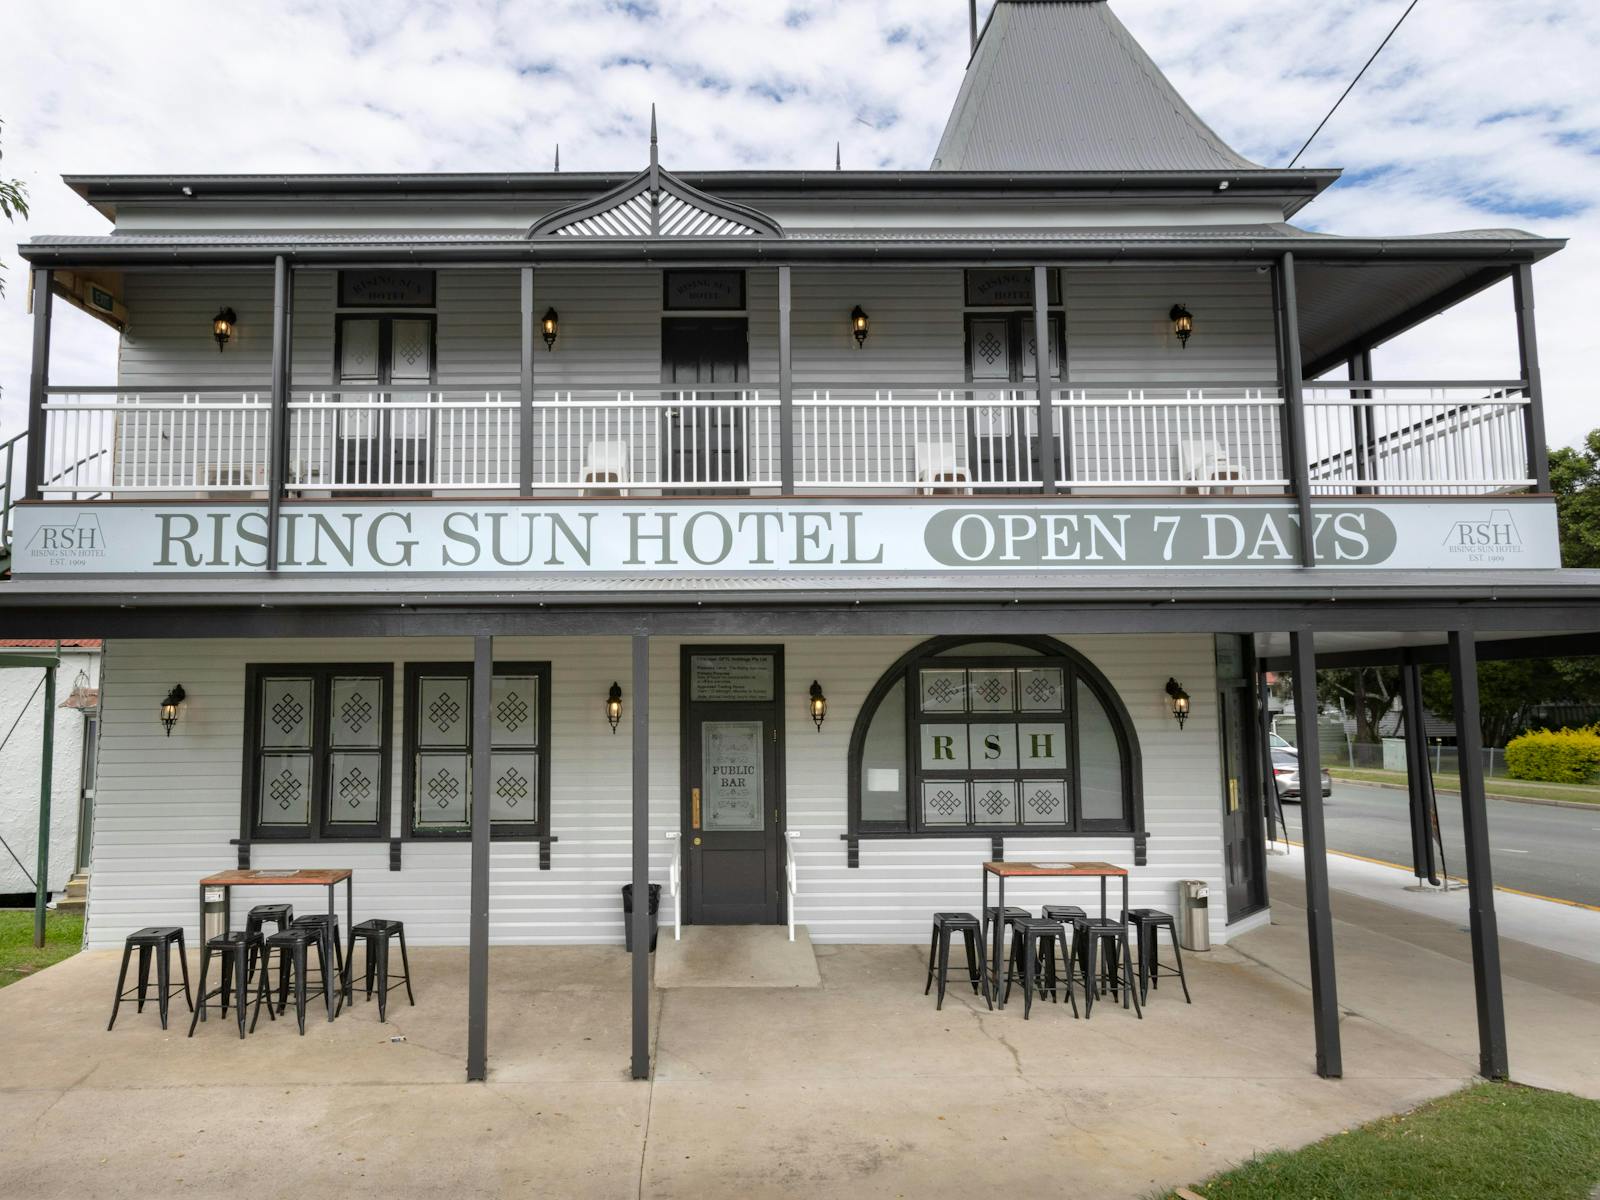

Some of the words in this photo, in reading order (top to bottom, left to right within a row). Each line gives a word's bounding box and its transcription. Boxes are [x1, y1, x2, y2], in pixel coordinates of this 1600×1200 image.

[42, 528, 96, 549] RSH
[153, 512, 419, 567] RISING
[442, 511, 598, 567] SUN
[622, 510, 882, 565] HOTEL
[950, 513, 1130, 561] OPEN
[1152, 515, 1181, 561] 7
[1458, 523, 1511, 545] RSH
[31, 549, 58, 557] RISING
[60, 549, 76, 557] SUN
[78, 549, 106, 557] HOTEL
[1449, 545, 1476, 553] RISING
[1477, 545, 1494, 553] SUN
[1495, 545, 1523, 553] HOTEL
[68, 559, 87, 567] 1909
[1487, 555, 1505, 564] 1909
[712, 765, 755, 775] PUBLIC
[721, 778, 746, 787] BAR
